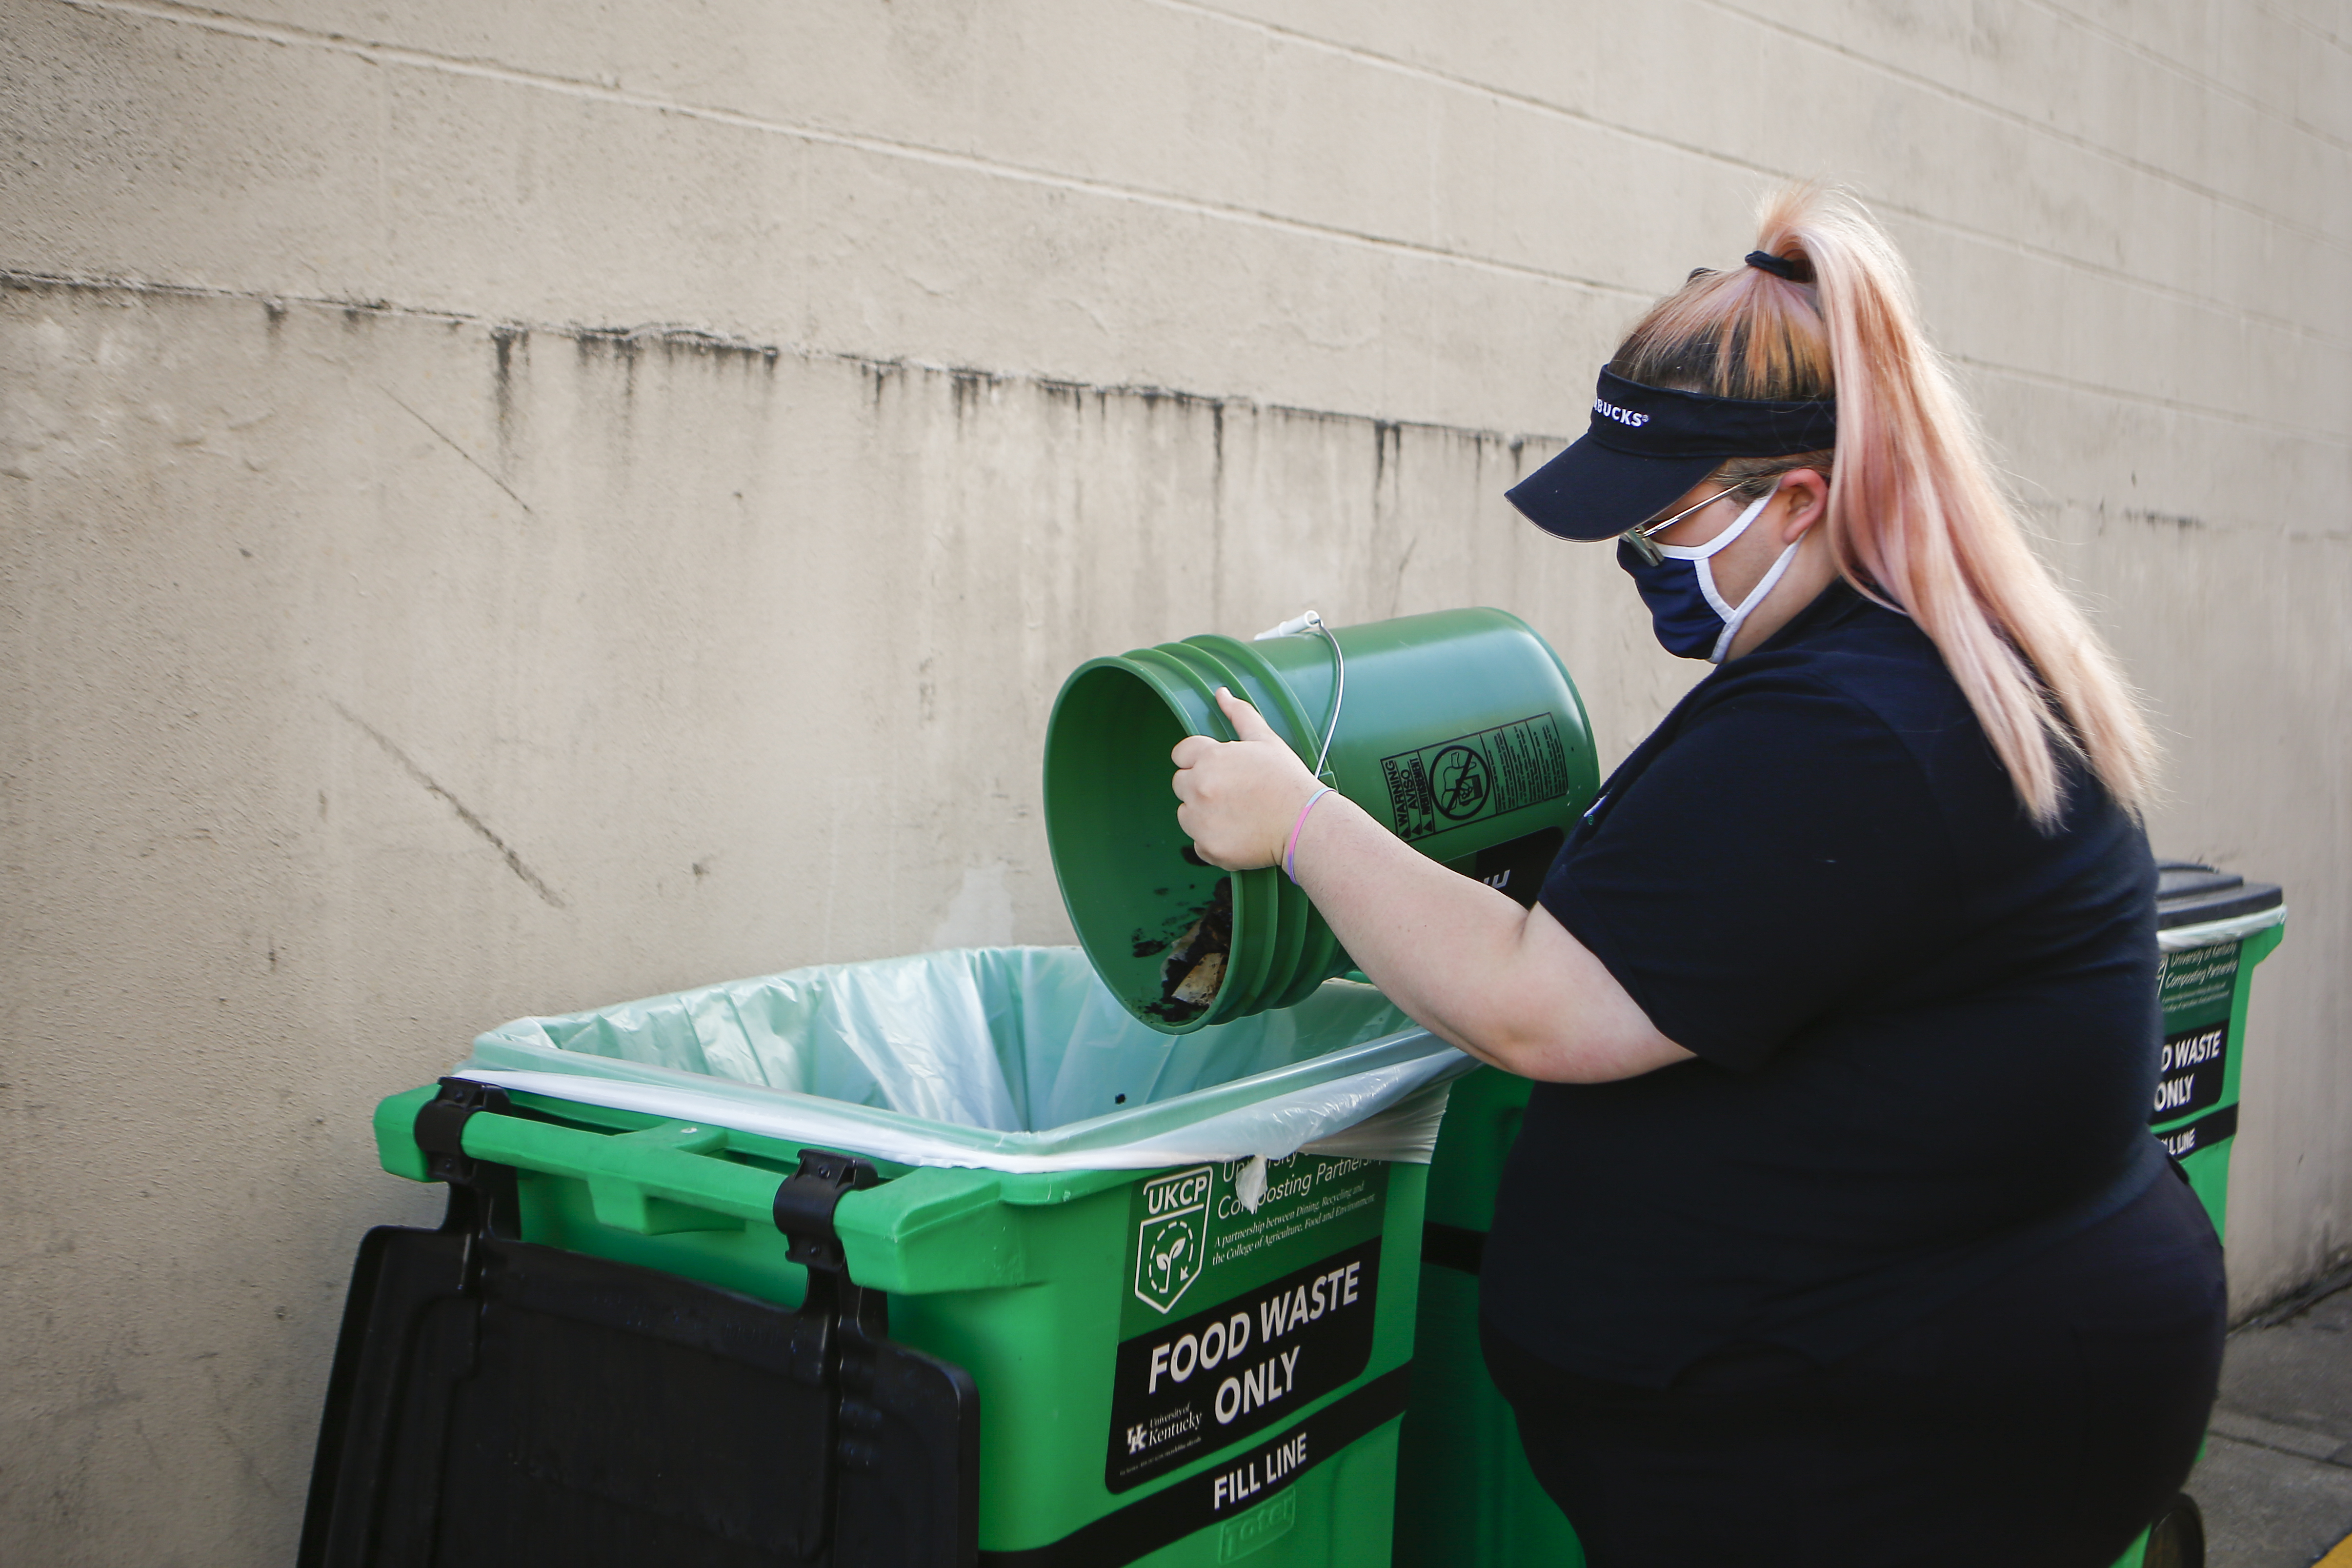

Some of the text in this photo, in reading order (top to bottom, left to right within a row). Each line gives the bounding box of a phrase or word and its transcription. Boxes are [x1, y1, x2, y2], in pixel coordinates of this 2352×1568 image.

[1385, 759, 1409, 827] WARNING
[1401, 768, 1418, 810] AVISO
[2175, 1029, 2222, 1069] WASTE
[2153, 1073, 2194, 1112] ONLY
[1147, 1176, 1207, 1215] UKCP
[1212, 1252, 1225, 1266] the
[1226, 1242, 1253, 1260] College
[1254, 1235, 1264, 1249] of
[1305, 1213, 1321, 1229] Food
[1322, 1207, 1335, 1222] and
[1335, 1194, 1375, 1217] Environment
[1215, 1236, 1220, 1248] A
[1222, 1222, 1265, 1248] partnership
[1266, 1211, 1294, 1229] between
[1149, 1262, 1360, 1394] FOOD WASTE
[1215, 1346, 1300, 1424] ONLY
[1149, 1411, 1202, 1447] Kentucky
[1150, 1407, 1183, 1428] University
[1214, 1432, 1307, 1510] FILL LINE
